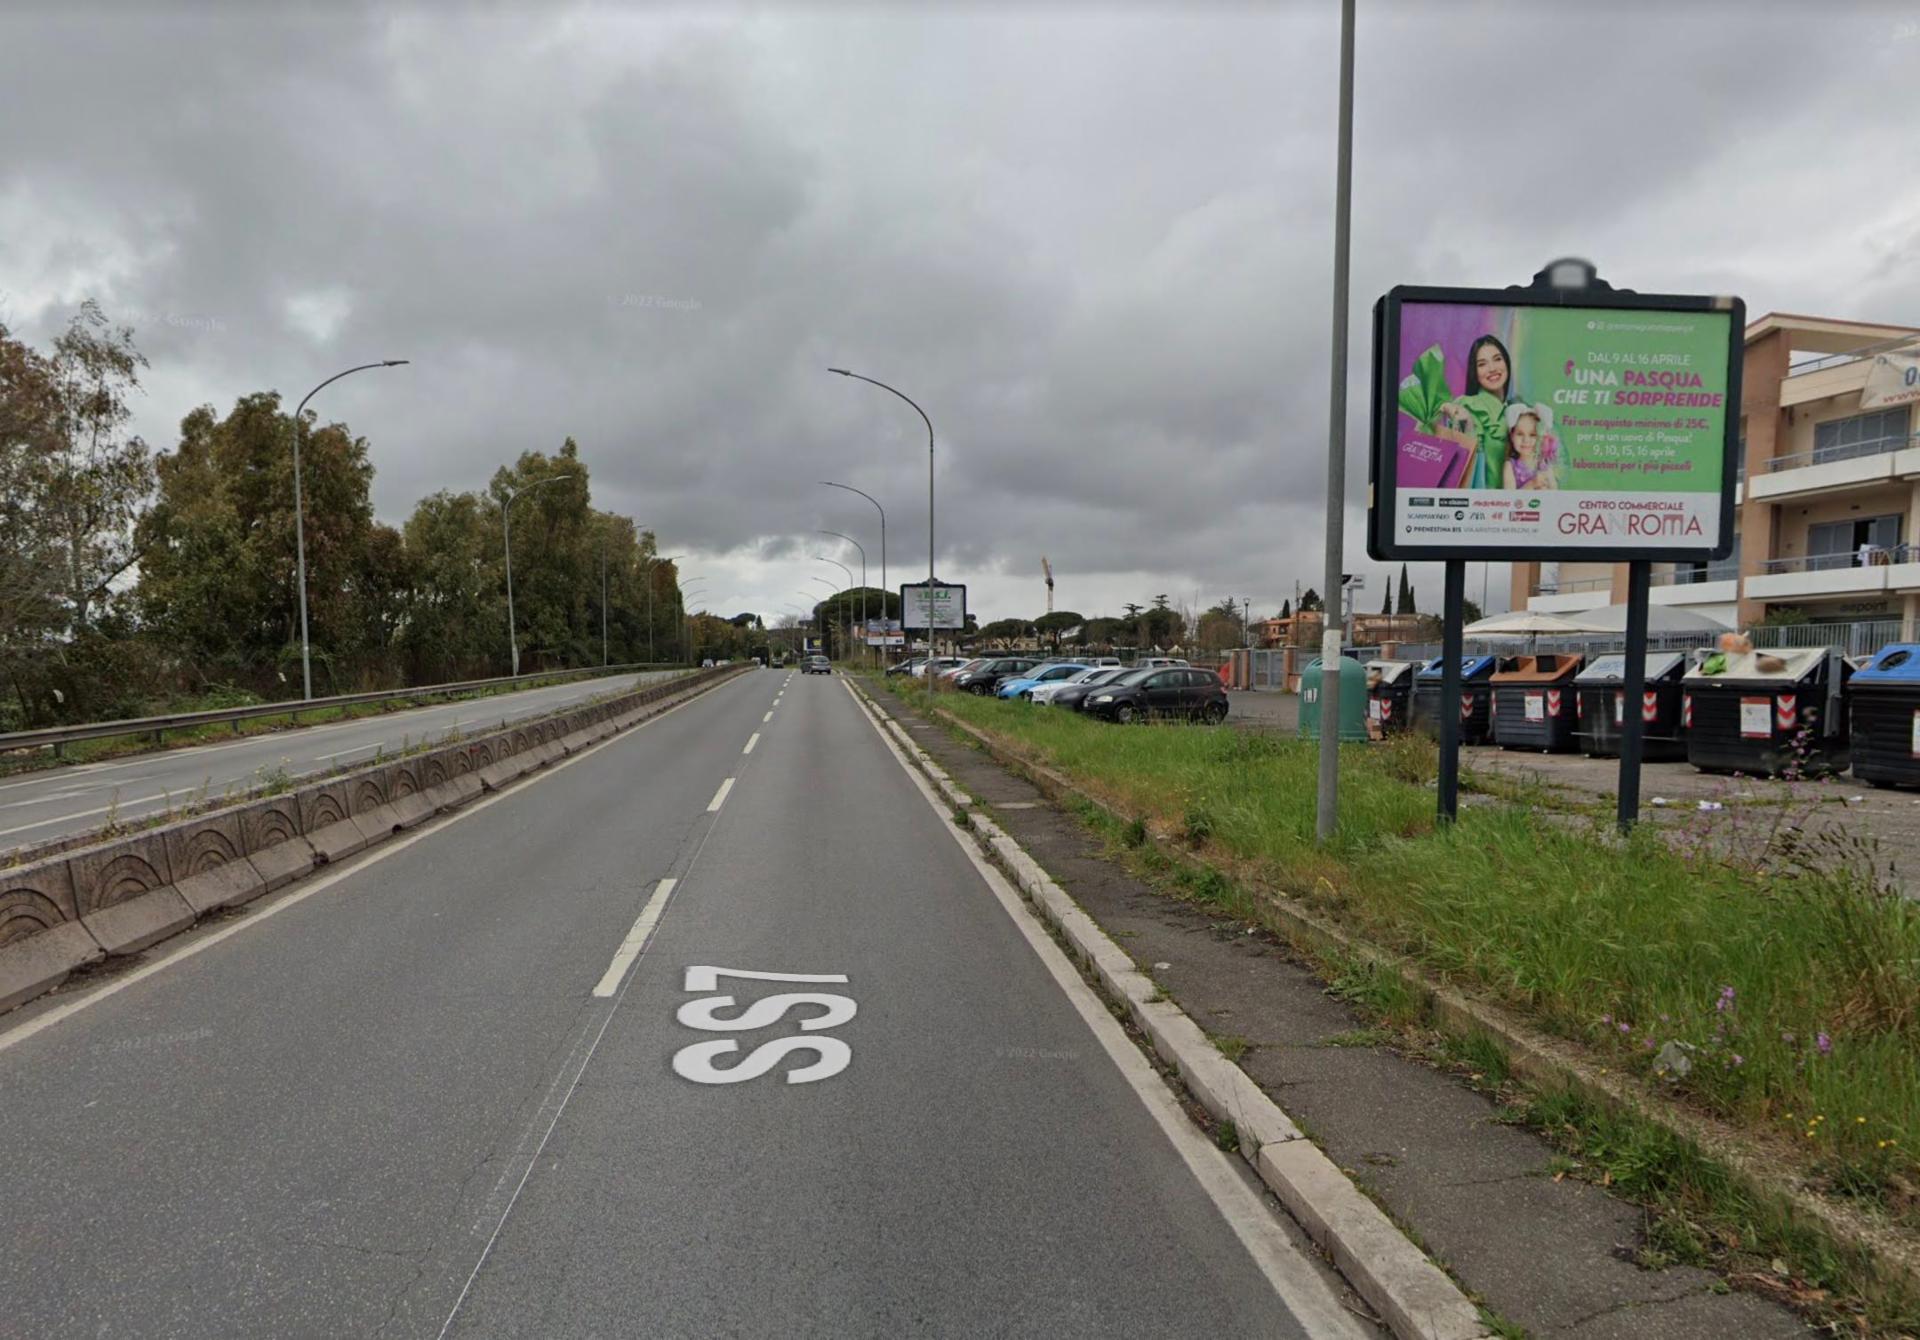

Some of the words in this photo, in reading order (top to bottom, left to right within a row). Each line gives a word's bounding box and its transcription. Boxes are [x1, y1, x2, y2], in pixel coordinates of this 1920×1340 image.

[1588, 352, 1610, 363] DAL
[1612, 353, 1620, 364] 9
[1622, 353, 1637, 364] AL
[1638, 354, 1649, 365] 16
[1650, 354, 1692, 366] APRILE
[1574, 369, 1618, 386] UNA
[1624, 370, 1703, 390] PASQUA
[1553, 389, 1588, 405] CHE
[1594, 390, 1610, 405] TI
[1614, 391, 1723, 407] SORPRENDE
[1578, 500, 1617, 510] CENTRO
[1618, 501, 1684, 511] COMMERCIALE
